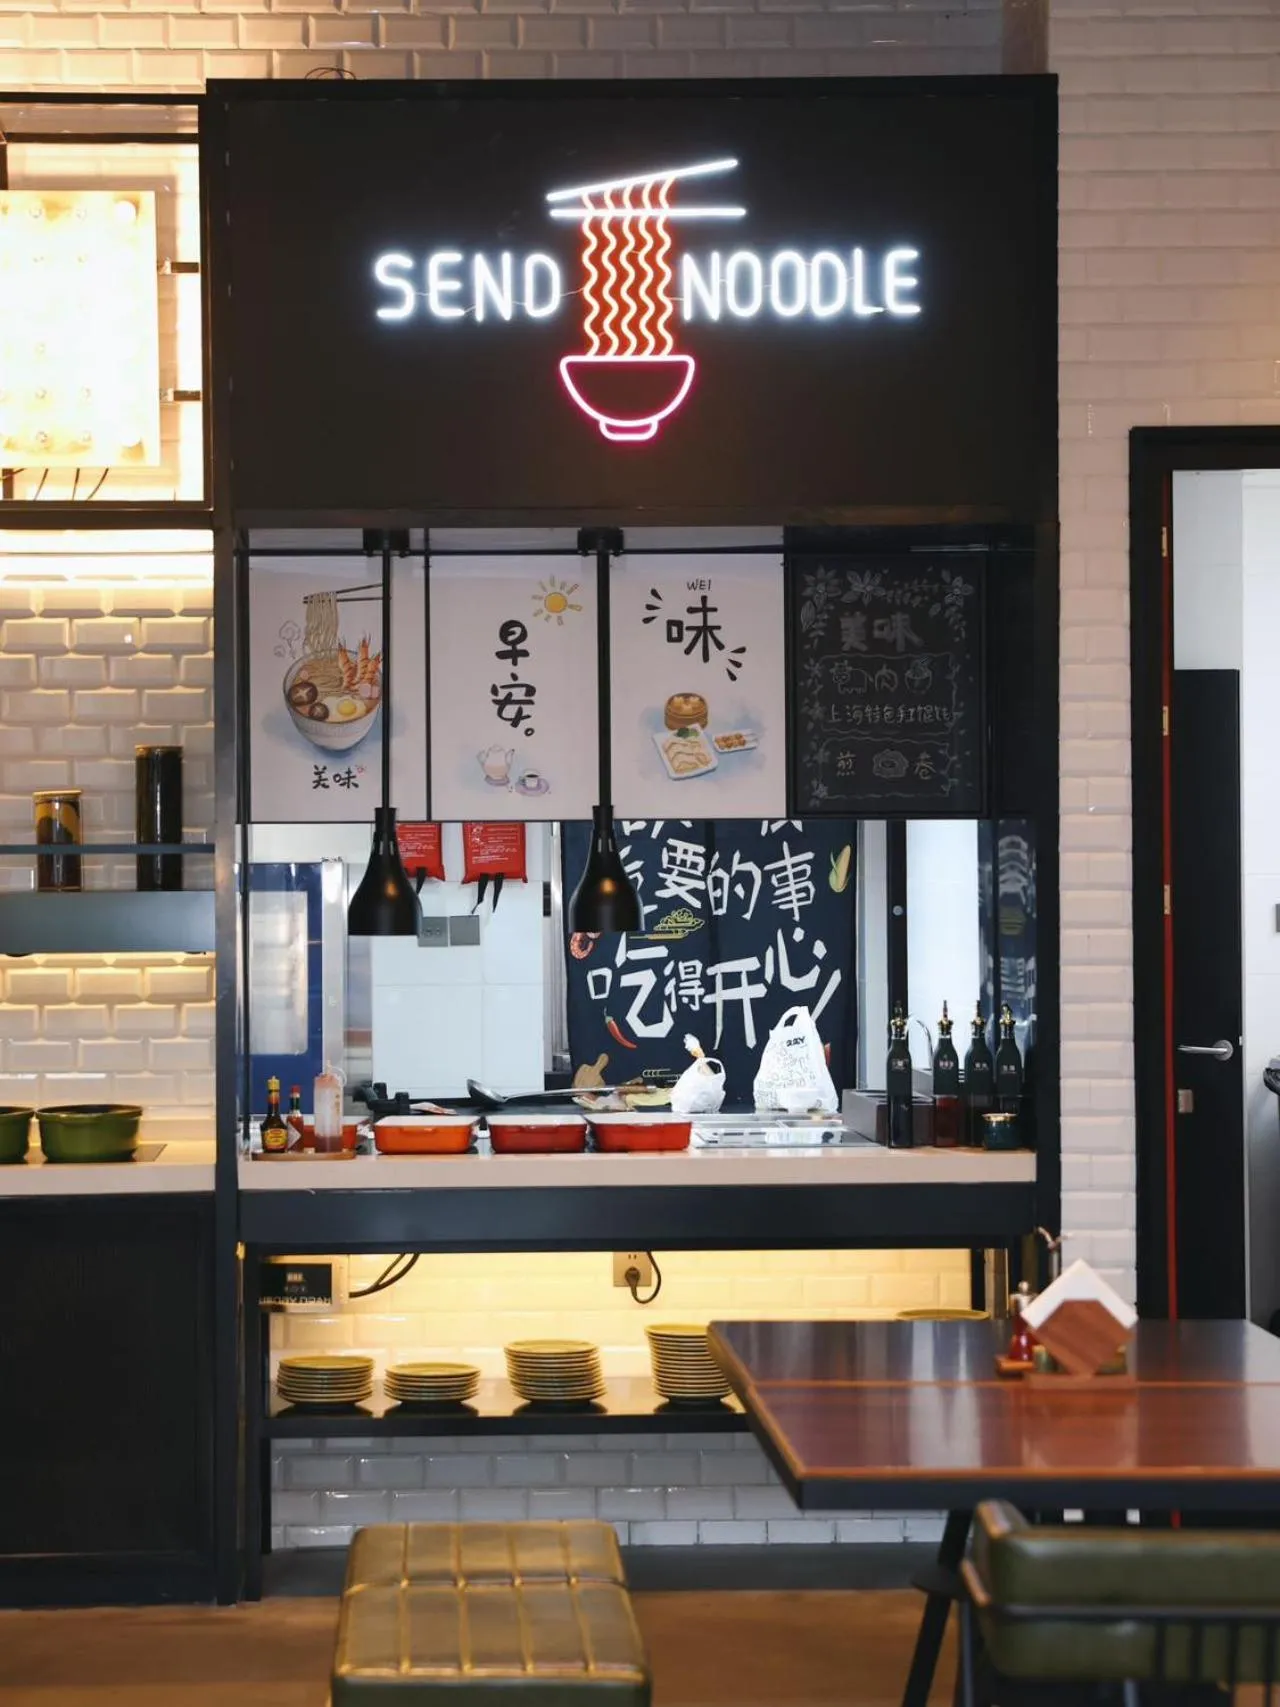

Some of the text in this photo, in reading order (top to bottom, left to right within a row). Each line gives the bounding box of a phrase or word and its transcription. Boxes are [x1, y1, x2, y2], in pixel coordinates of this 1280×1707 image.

[374, 247, 921, 321] SEND NOODLE
[686, 579, 712, 591] WEI
[666, 595, 726, 663] 味
[839, 610, 926, 652] 美味
[311, 764, 360, 789] 美味
